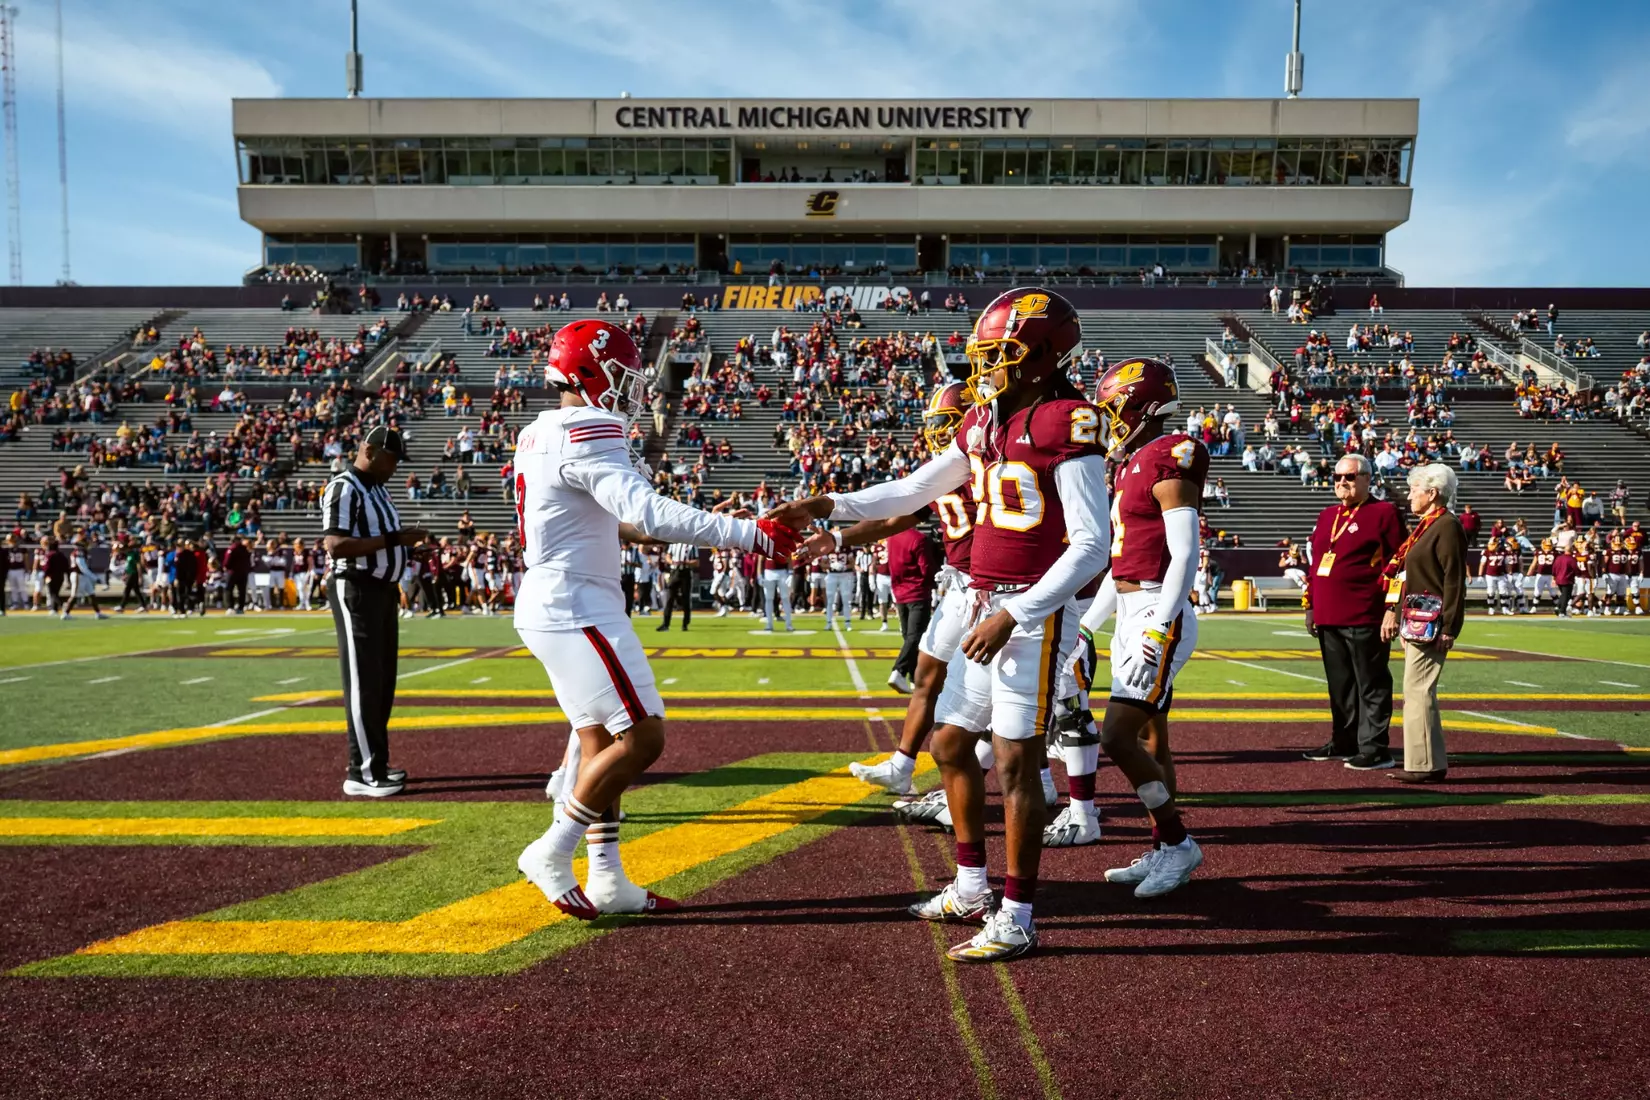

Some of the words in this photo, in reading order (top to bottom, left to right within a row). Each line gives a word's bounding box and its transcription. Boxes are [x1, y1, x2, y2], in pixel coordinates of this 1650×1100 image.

[615, 106, 732, 129] CENTRAL
[738, 106, 870, 129] MICHIGAN
[877, 106, 1030, 129] UNIVERSITY
[592, 325, 611, 350] 3
[1171, 439, 1196, 470] 4
[969, 453, 1045, 532] 20
[1488, 555, 1505, 567] 77
